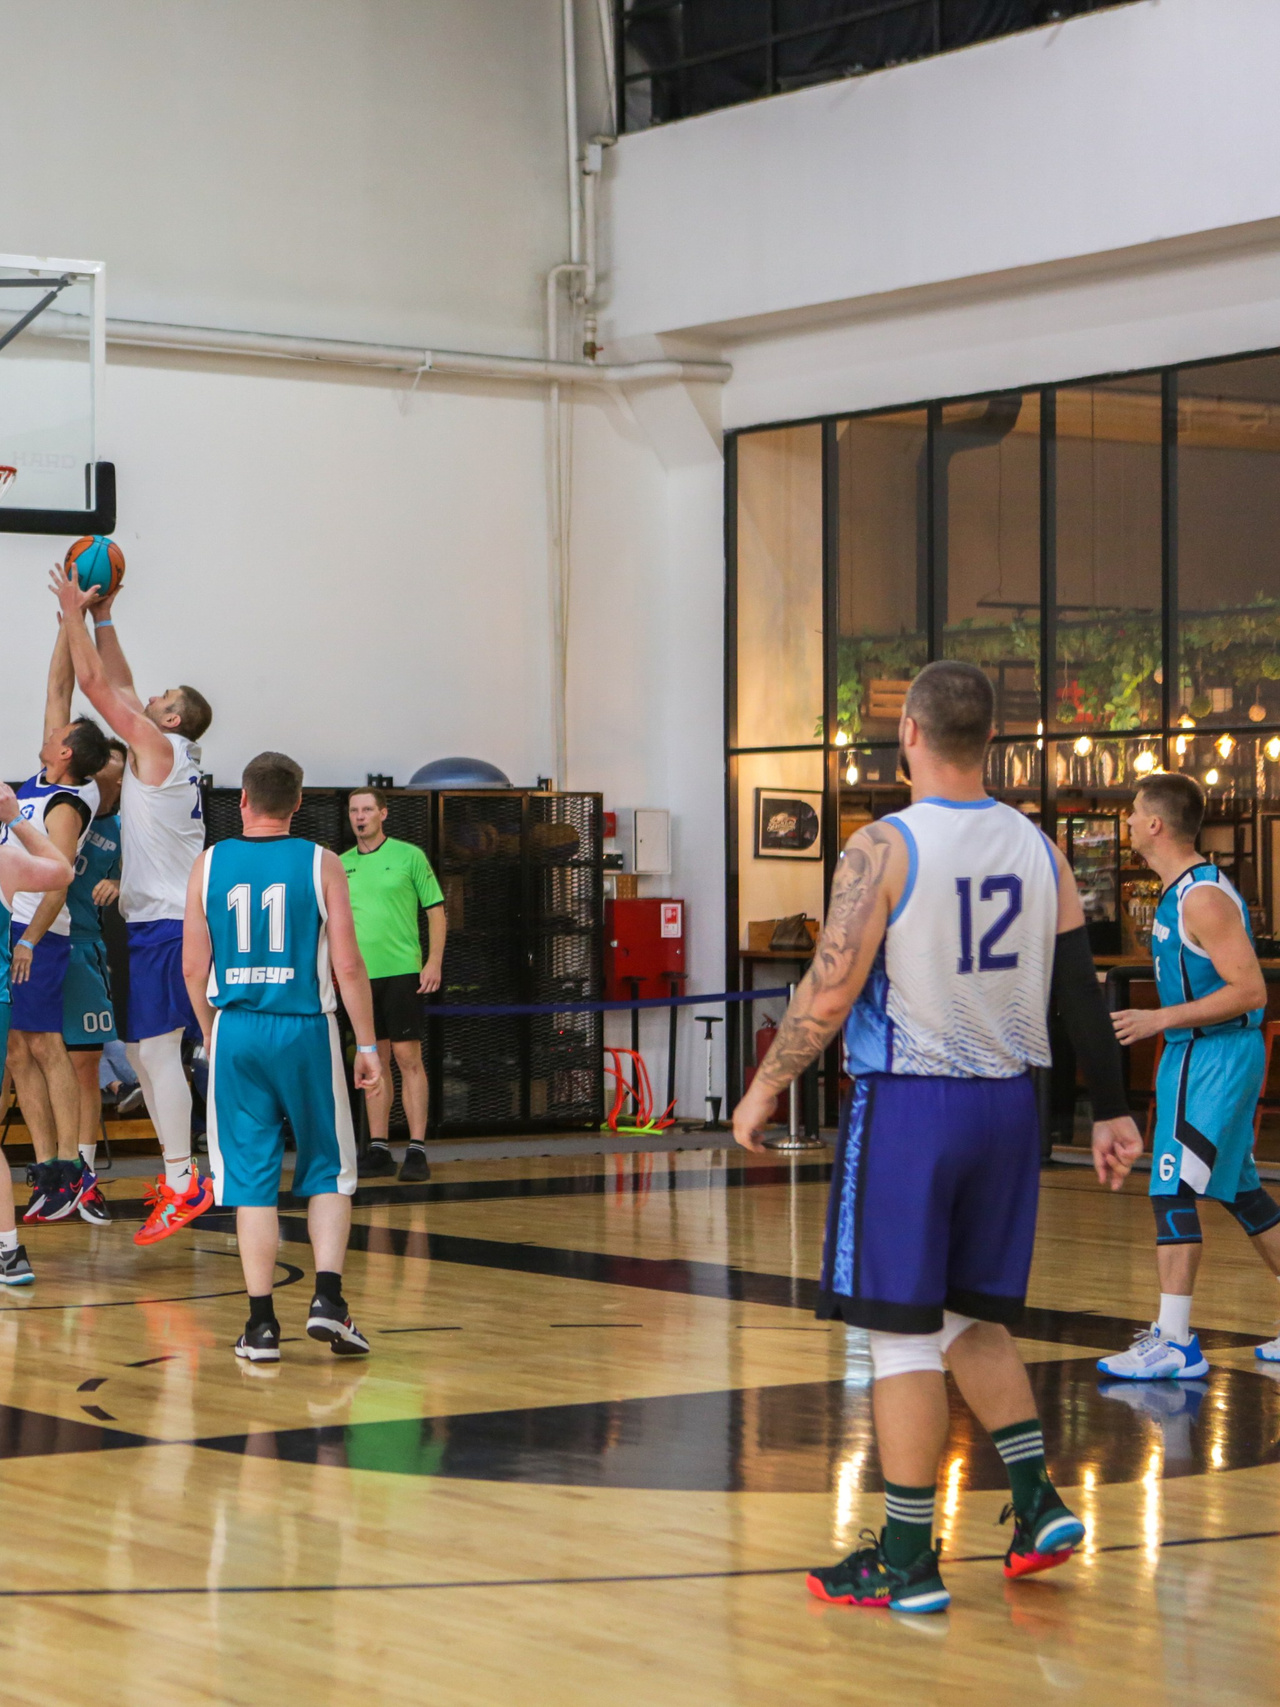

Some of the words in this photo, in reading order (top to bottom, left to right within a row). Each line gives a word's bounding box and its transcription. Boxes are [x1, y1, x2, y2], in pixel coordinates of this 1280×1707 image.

[227, 883, 286, 953] 11
[955, 873, 1023, 974] 12
[225, 966, 295, 984] СИБУР
[82, 1010, 113, 1033] 00
[1159, 1153, 1176, 1182] 6
